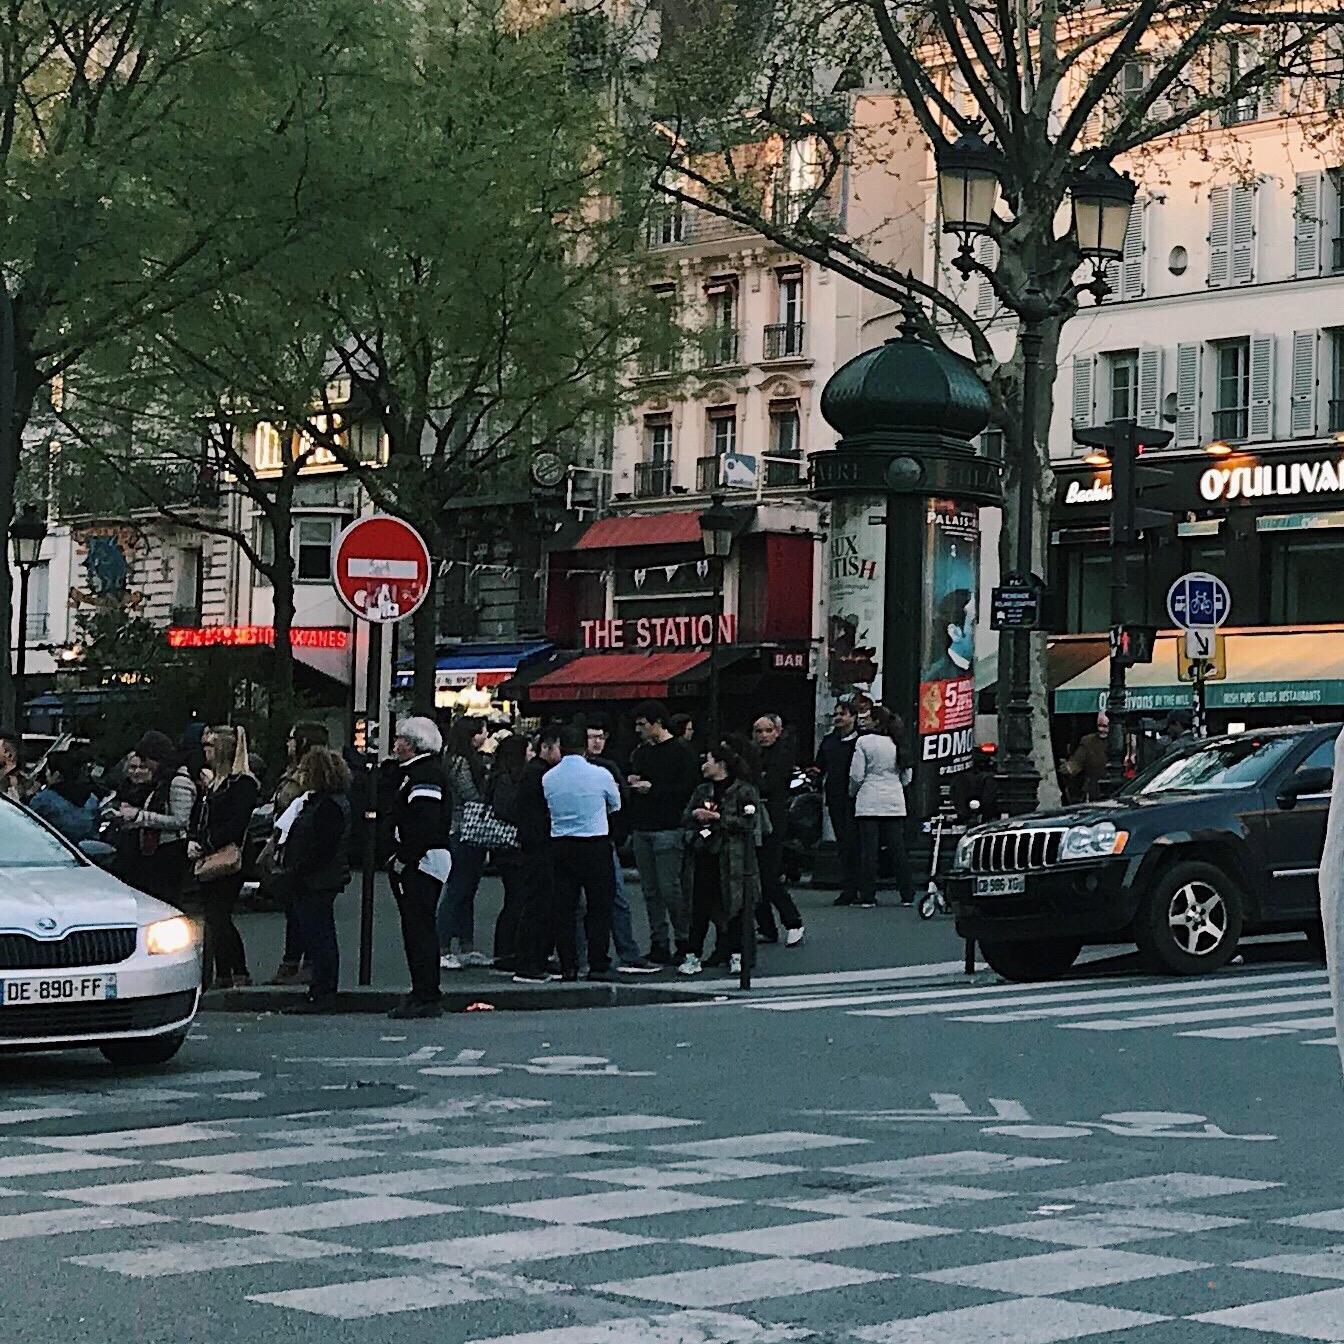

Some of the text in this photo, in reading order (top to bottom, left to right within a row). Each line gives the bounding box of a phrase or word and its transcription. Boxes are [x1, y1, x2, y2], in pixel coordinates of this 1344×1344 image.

[581, 614, 733, 649] THE STATION
[775, 654, 803, 667] BAR
[945, 682, 958, 707] 5
